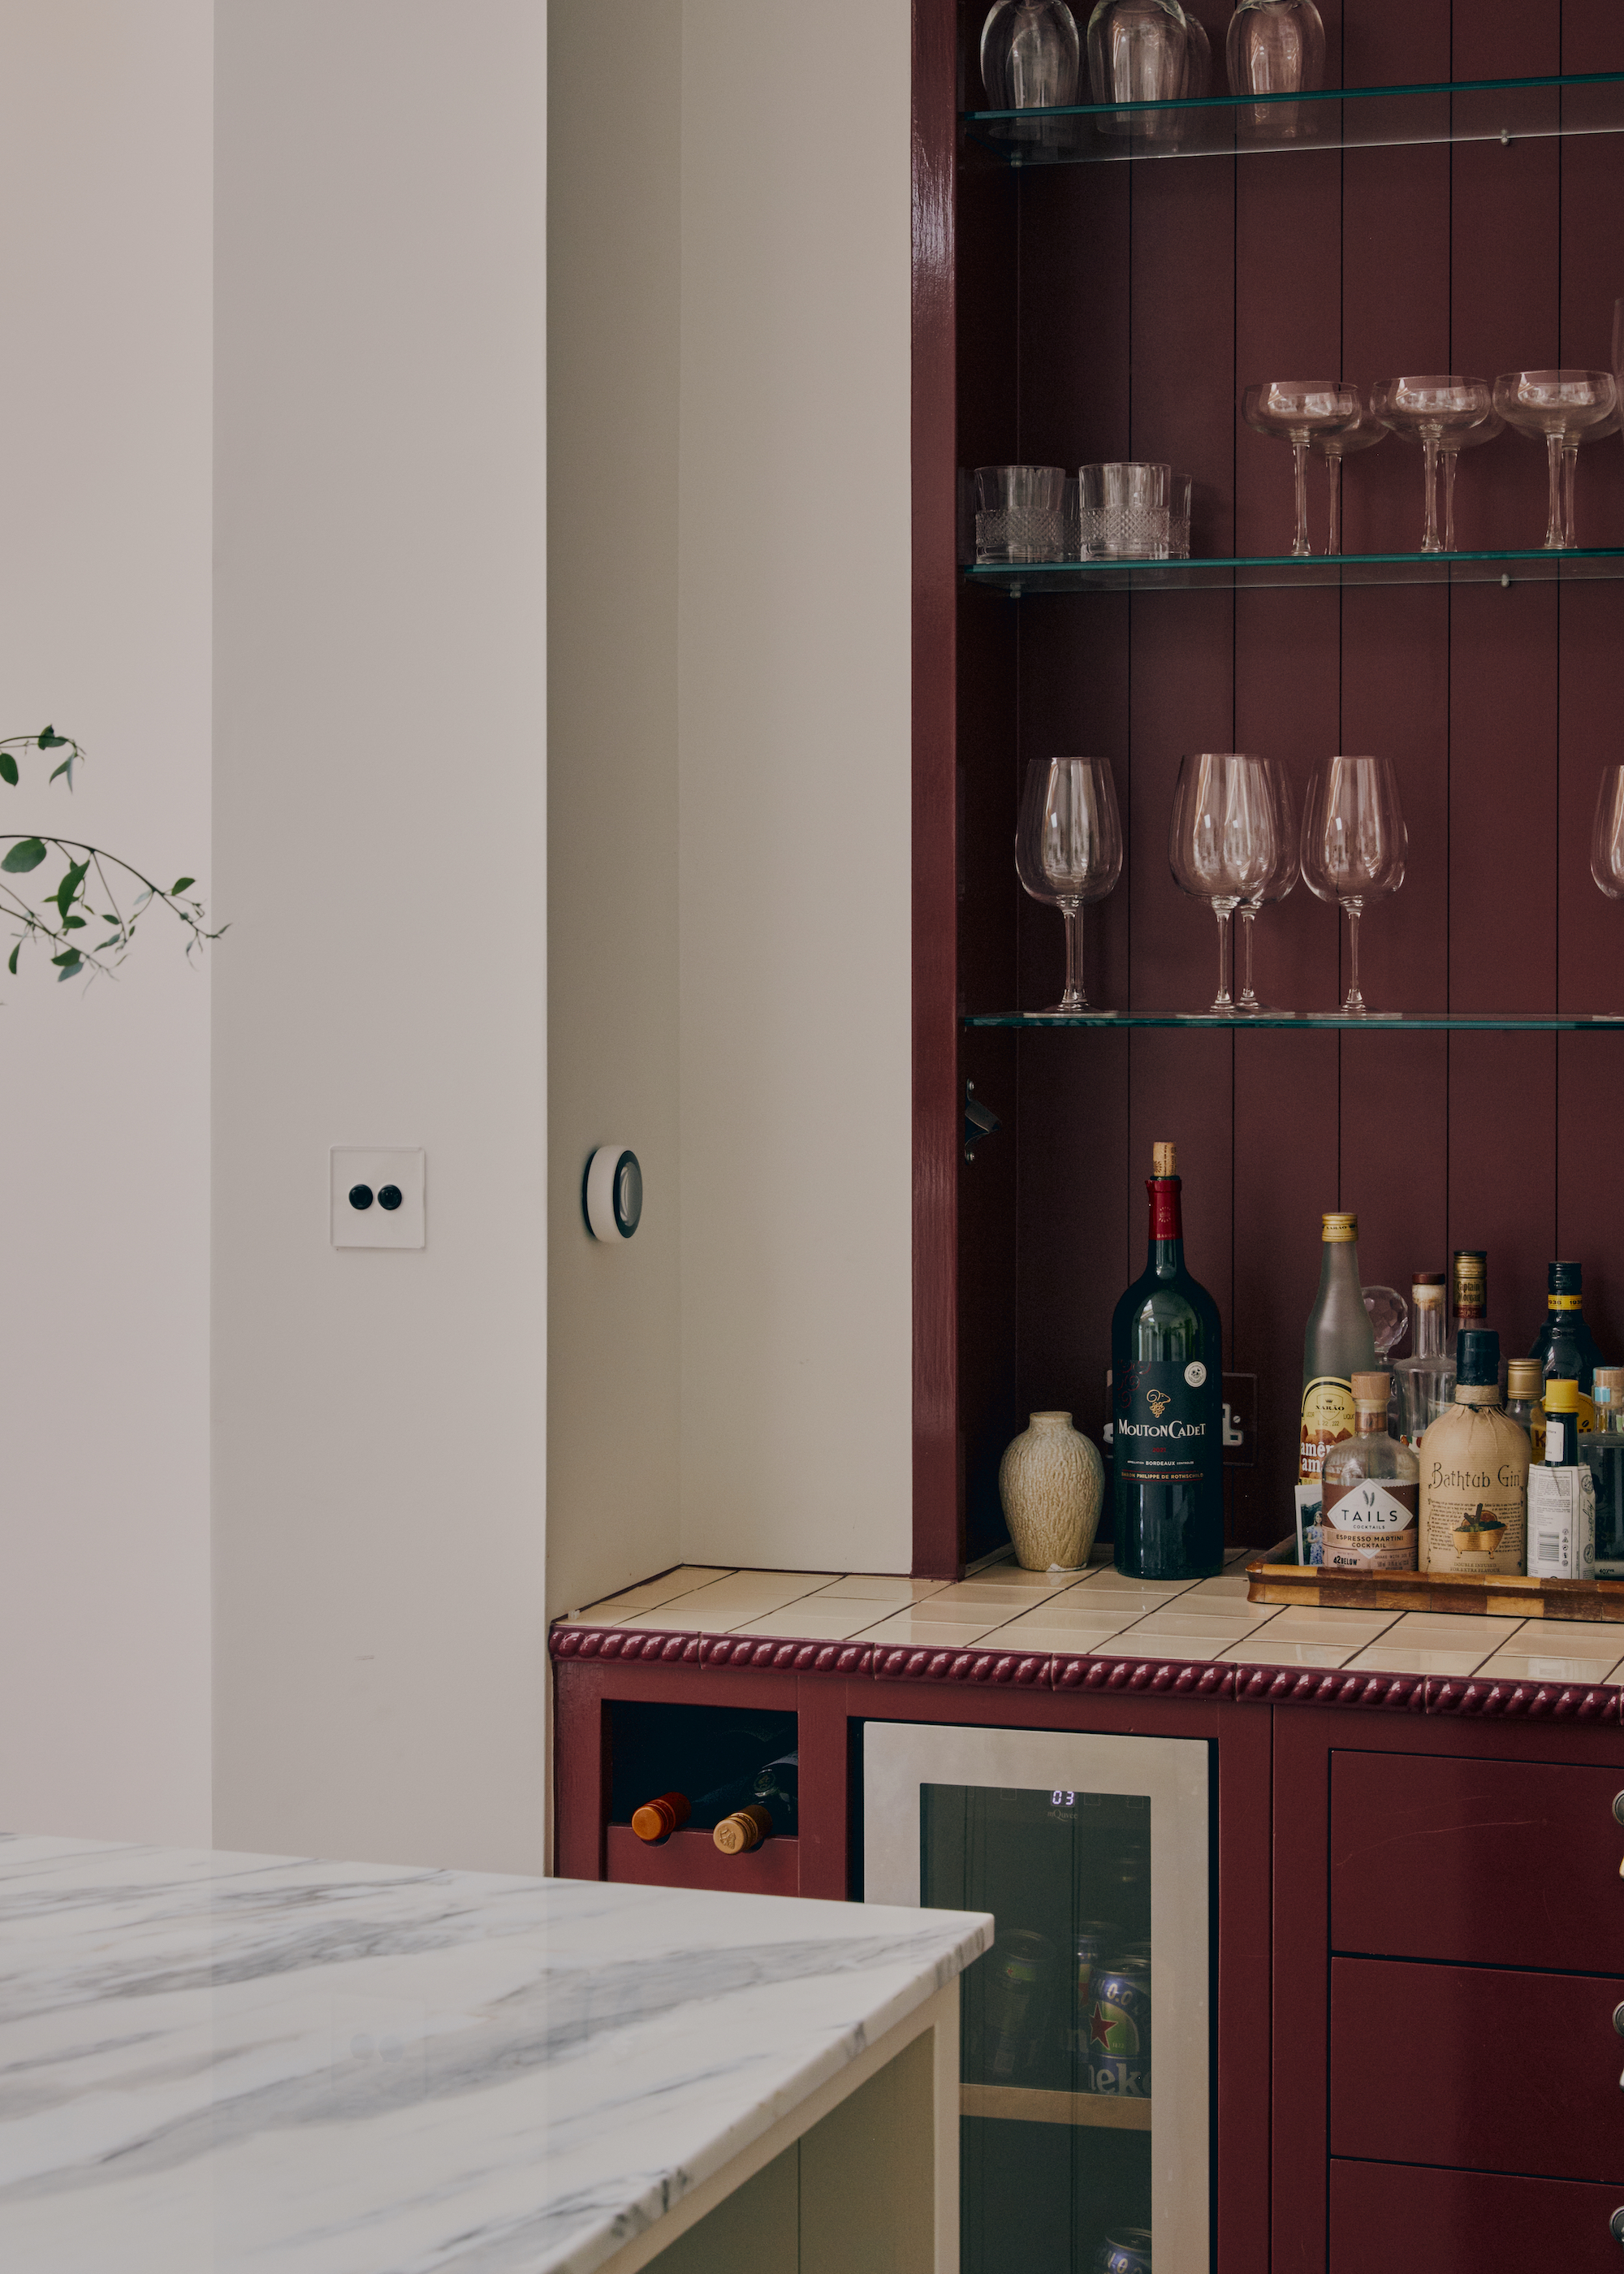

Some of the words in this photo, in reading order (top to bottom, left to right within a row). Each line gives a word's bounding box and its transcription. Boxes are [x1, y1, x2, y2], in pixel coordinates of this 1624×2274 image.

[1457, 1281, 1480, 1293] Captain
[1457, 1292, 1481, 1303] Morgan
[1432, 1462, 1491, 1490] Bathtub
[1341, 1509, 1398, 1522] TAILS
[1052, 1790, 1074, 1805] 03
[1107, 1983, 1133, 2006] 0.0
